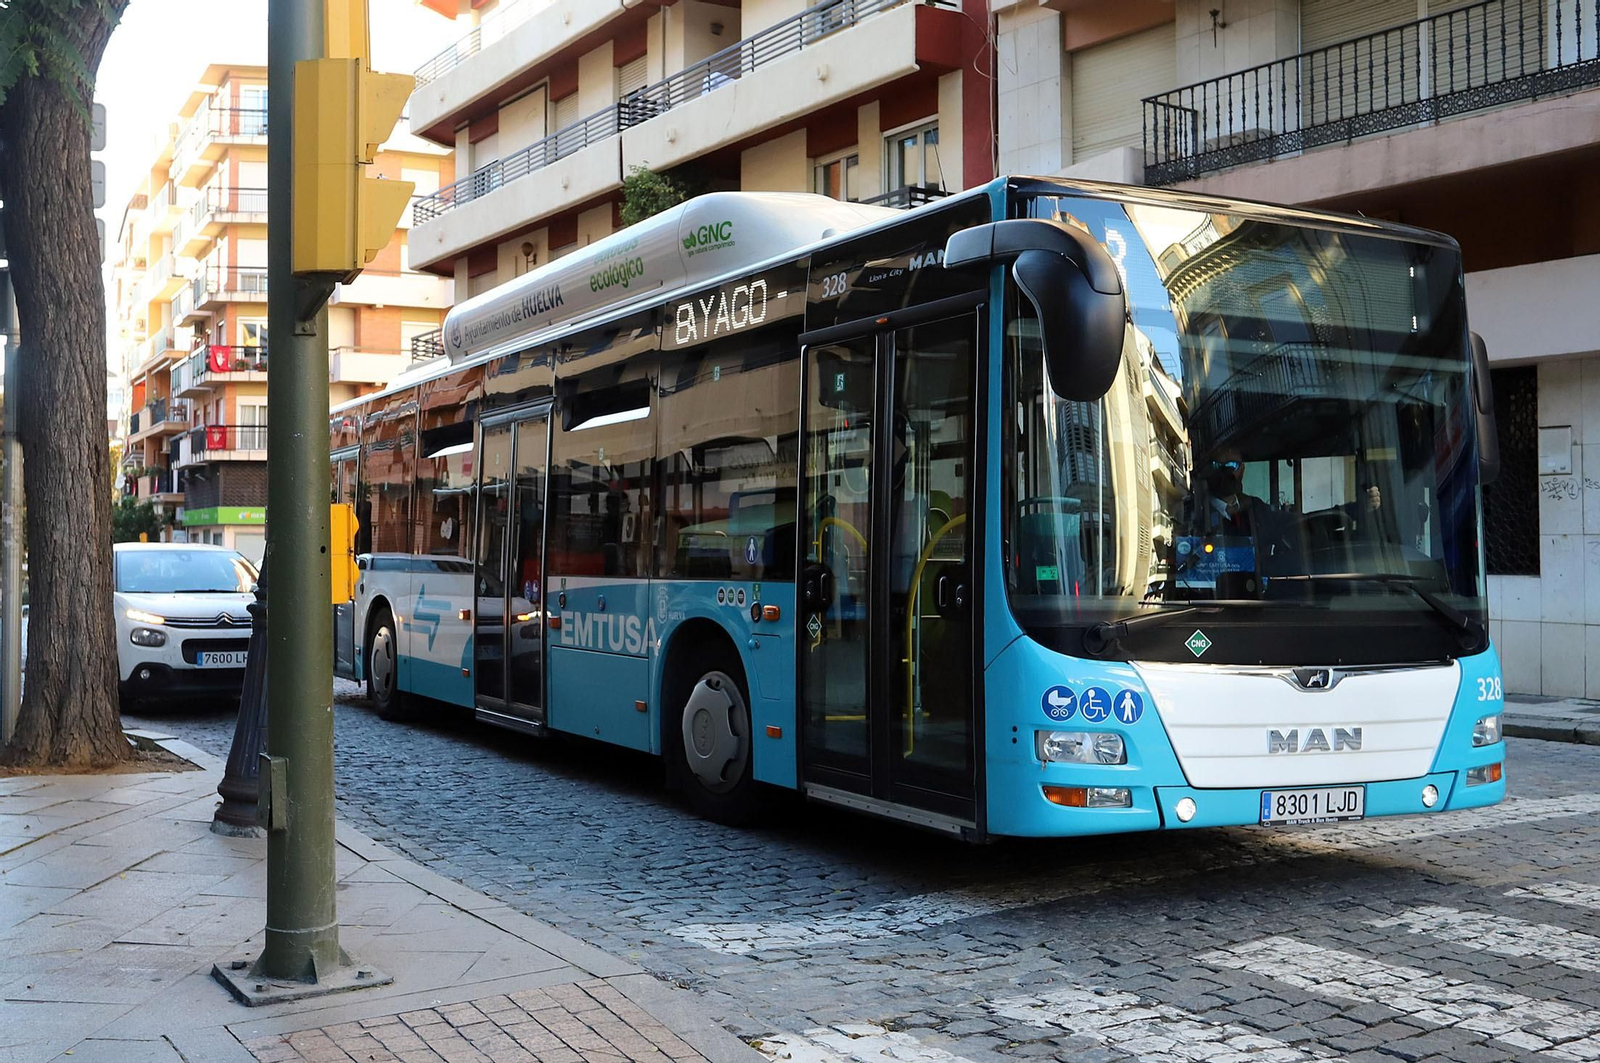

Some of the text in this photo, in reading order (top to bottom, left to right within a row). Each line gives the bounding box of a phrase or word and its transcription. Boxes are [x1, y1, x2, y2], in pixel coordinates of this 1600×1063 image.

[697, 220, 732, 246] GNC
[708, 240, 736, 251] comprimido
[589, 256, 644, 292] ecológico
[821, 271, 847, 298] 328
[869, 268, 904, 283] Lion's City
[464, 284, 564, 345] Ayuntamiento de HUELVA
[561, 611, 659, 656] EMTUSA
[1191, 639, 1206, 648] CNG
[204, 653, 233, 664] 7600
[1476, 676, 1502, 702] 328
[1266, 727, 1362, 754] MAN
[1276, 793, 1318, 816] 8301
[1326, 791, 1358, 813] LJD
